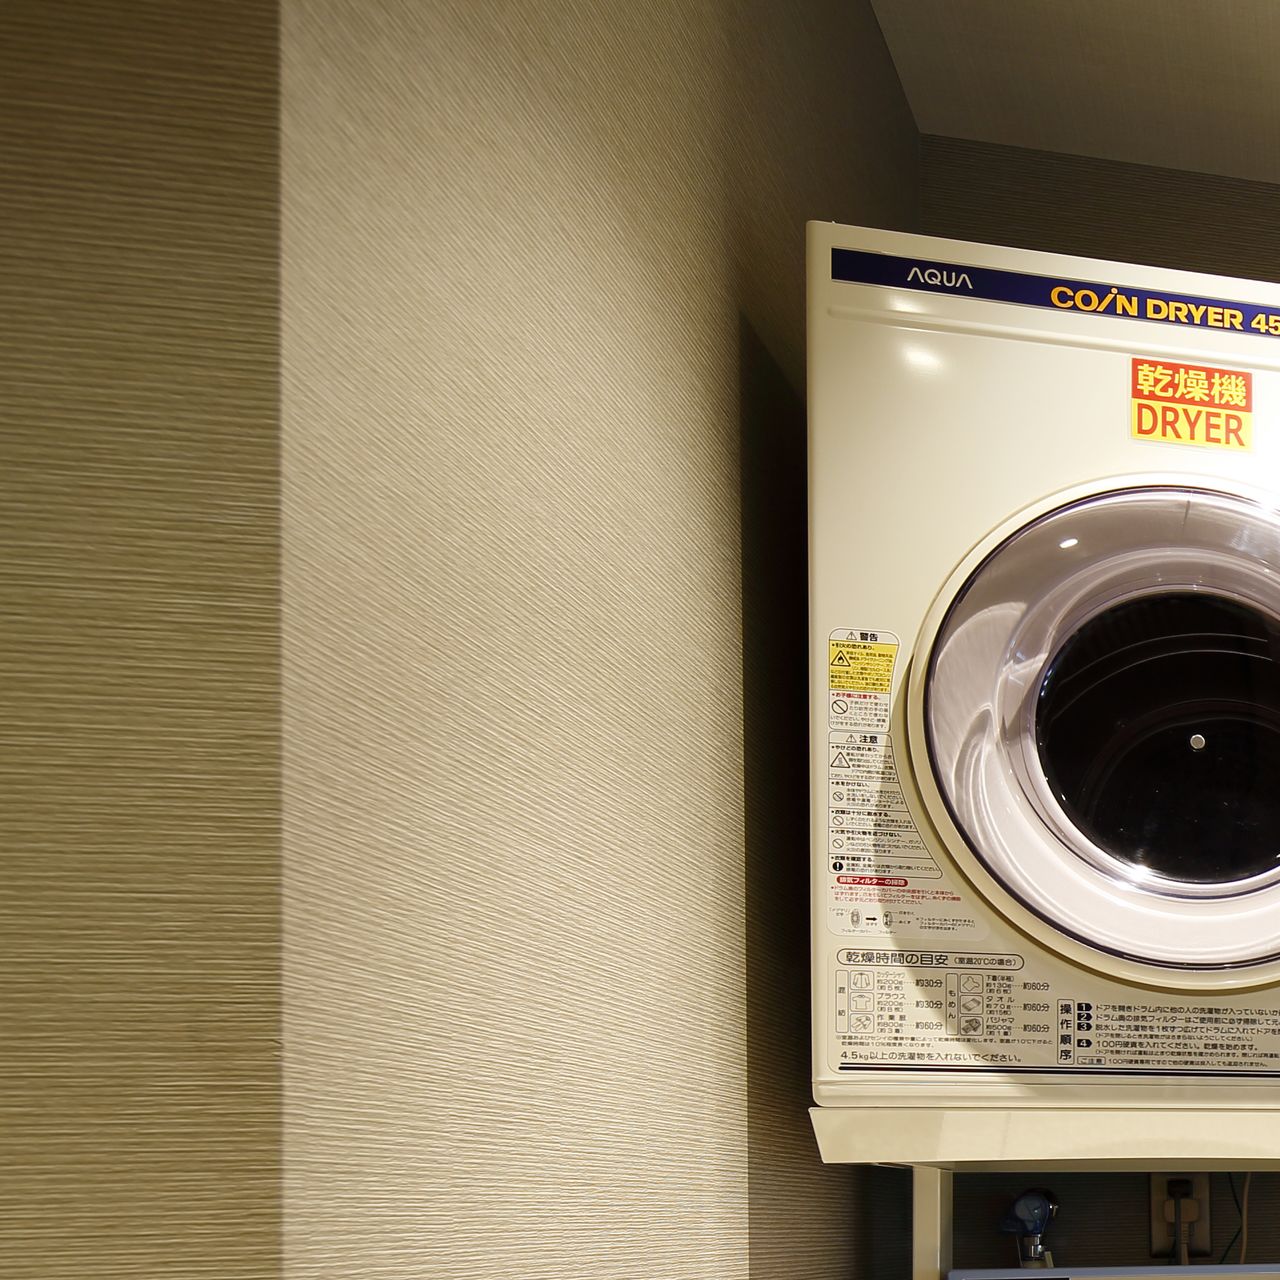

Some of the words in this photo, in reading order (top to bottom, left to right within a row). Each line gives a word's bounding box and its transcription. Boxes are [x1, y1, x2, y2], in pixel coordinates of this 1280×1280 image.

[907, 267, 973, 289] AQUA
[1146, 299, 1244, 331] DRYER
[1137, 363, 1247, 408] 乾燥機
[1136, 402, 1247, 448] DRYER
[846, 952, 948, 966] 乾燥時間の目安
[1060, 1004, 1072, 1060] 操作順序
